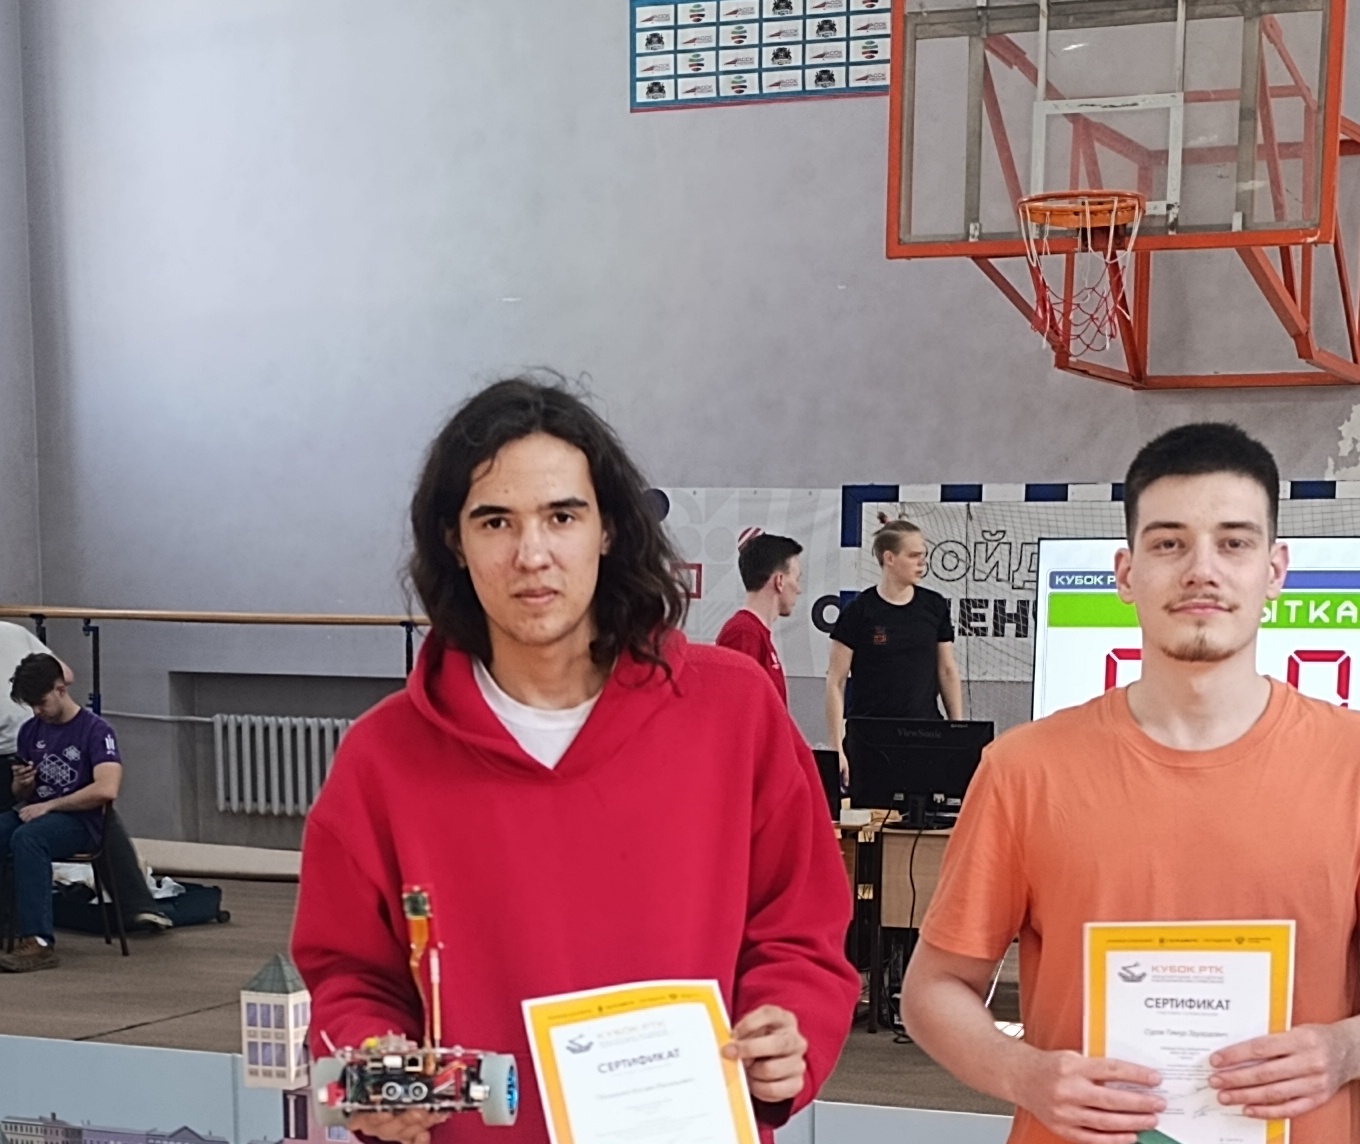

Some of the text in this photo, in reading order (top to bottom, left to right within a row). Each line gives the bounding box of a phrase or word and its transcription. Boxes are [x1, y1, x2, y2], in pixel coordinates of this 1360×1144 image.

[1055, 575, 1104, 586] КУБОК
[1260, 600, 1359, 624] ЫТКА
[897, 728, 943, 740] ViewSonic
[1151, 965, 1225, 974] КУБОК РТК
[1144, 997, 1231, 1011] СЕРТИФИКАТ
[597, 1047, 681, 1074] СЕРТИФИКАТ
